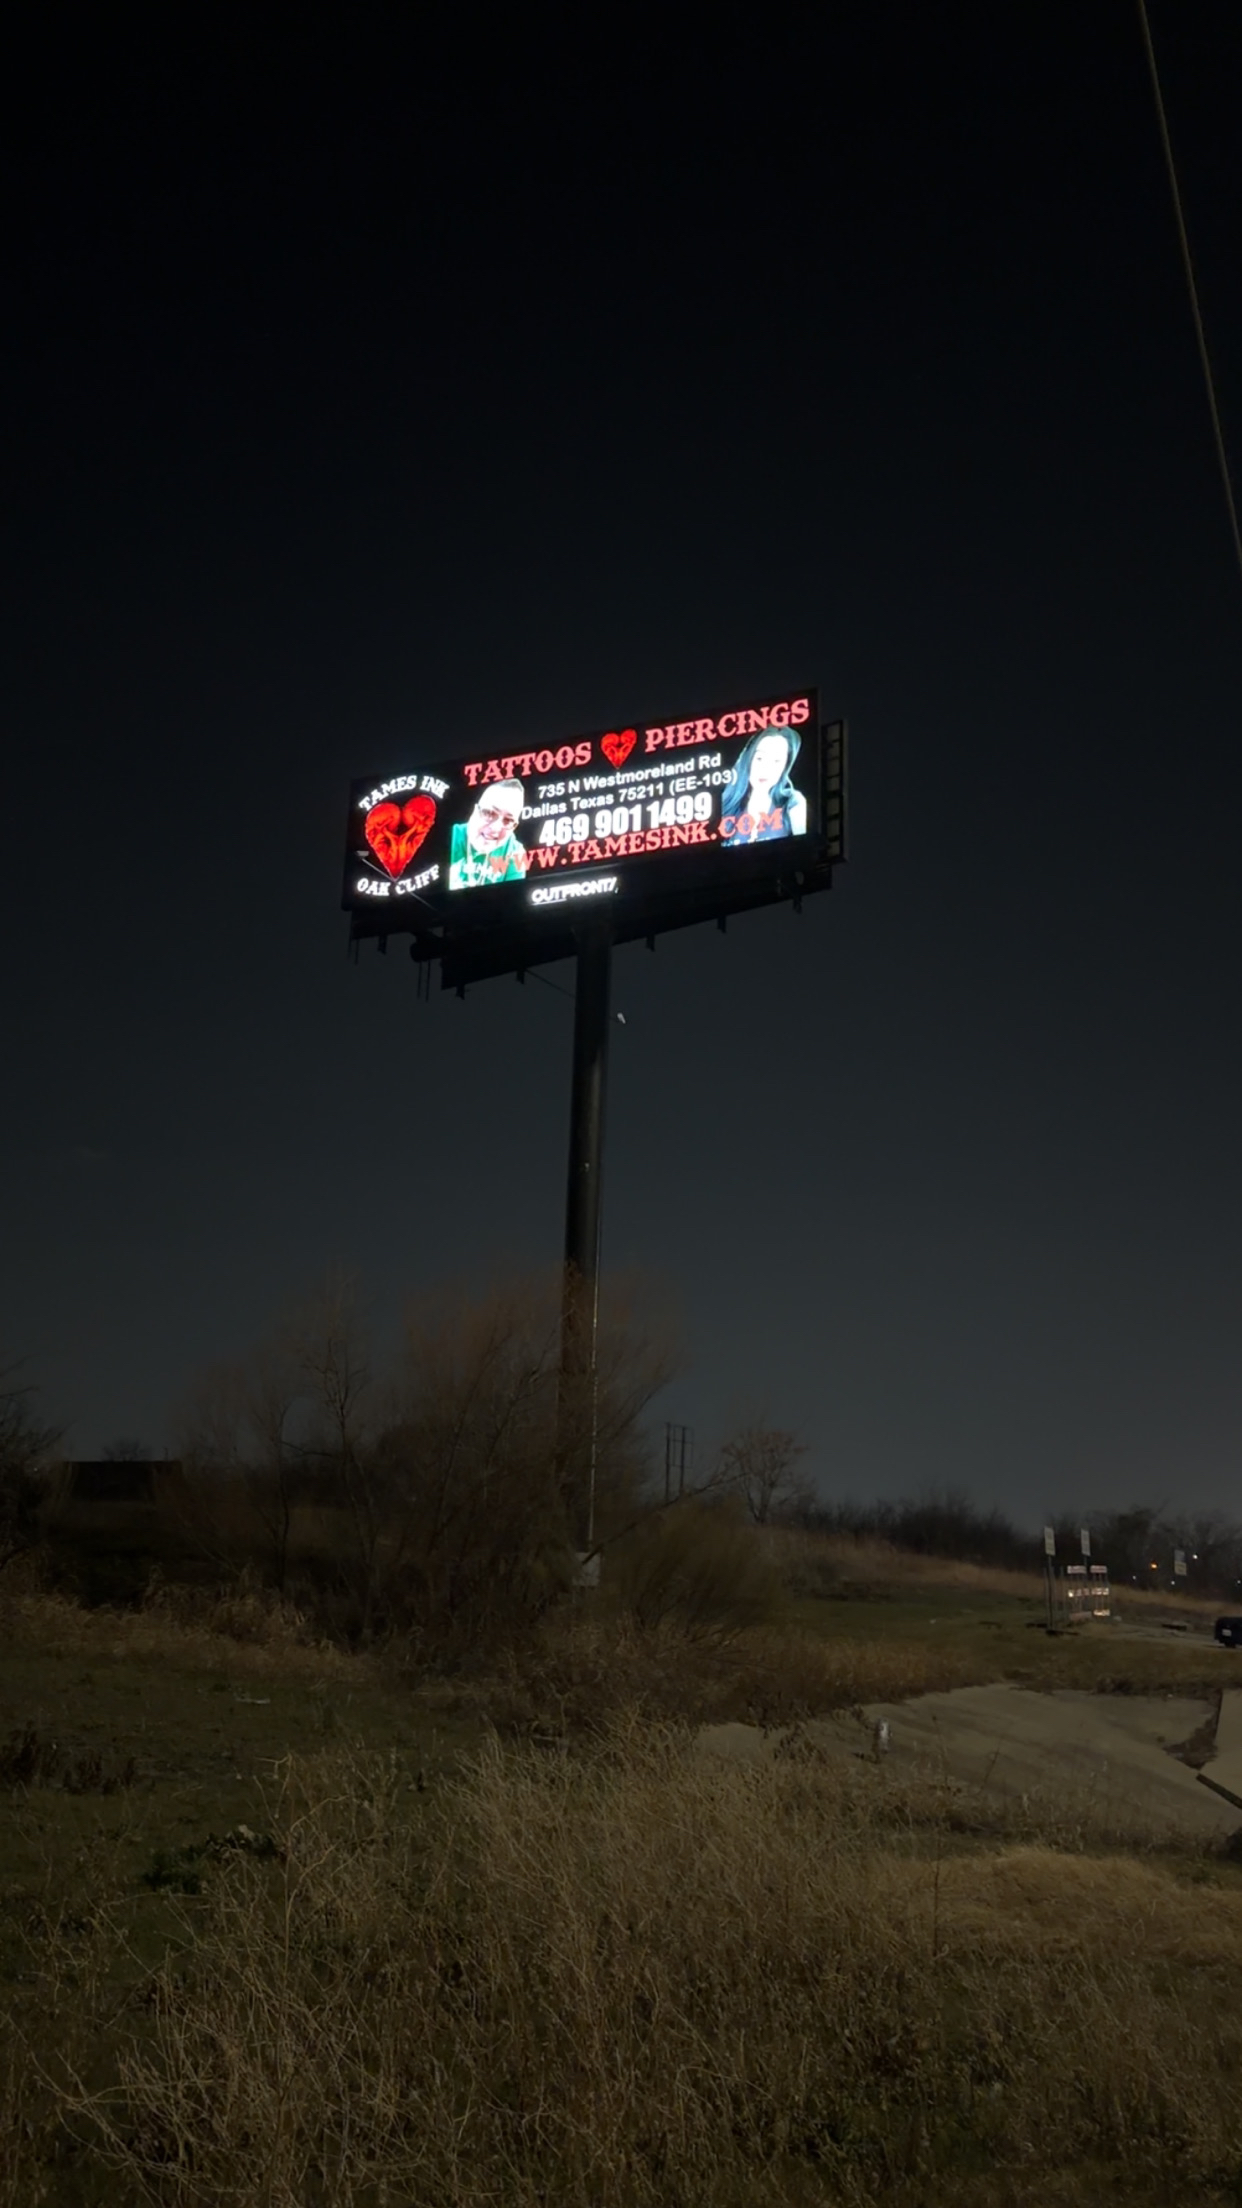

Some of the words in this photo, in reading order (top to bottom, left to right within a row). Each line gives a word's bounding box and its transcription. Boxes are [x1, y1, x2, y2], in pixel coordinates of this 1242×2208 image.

[464, 741, 592, 786] TATTOOS
[644, 699, 810, 752] PIERCINGS
[359, 775, 417, 811] TAMES
[421, 776, 450, 799] INK
[522, 801, 567, 820] Dallas
[571, 793, 614, 811] Texas
[619, 782, 664, 802] 75211
[669, 769, 738, 796] (EE-103)
[538, 783, 565, 799] 735
[568, 780, 580, 794] N
[584, 758, 695, 790] Westmoreland
[698, 753, 722, 769] Rd
[489, 807, 784, 874] WWW.TAMESINK.COM
[539, 813, 590, 847] 469
[595, 804, 642, 838] 901
[647, 791, 713, 829] 1499
[357, 877, 391, 896] OAK
[395, 864, 440, 895] CLIFF
